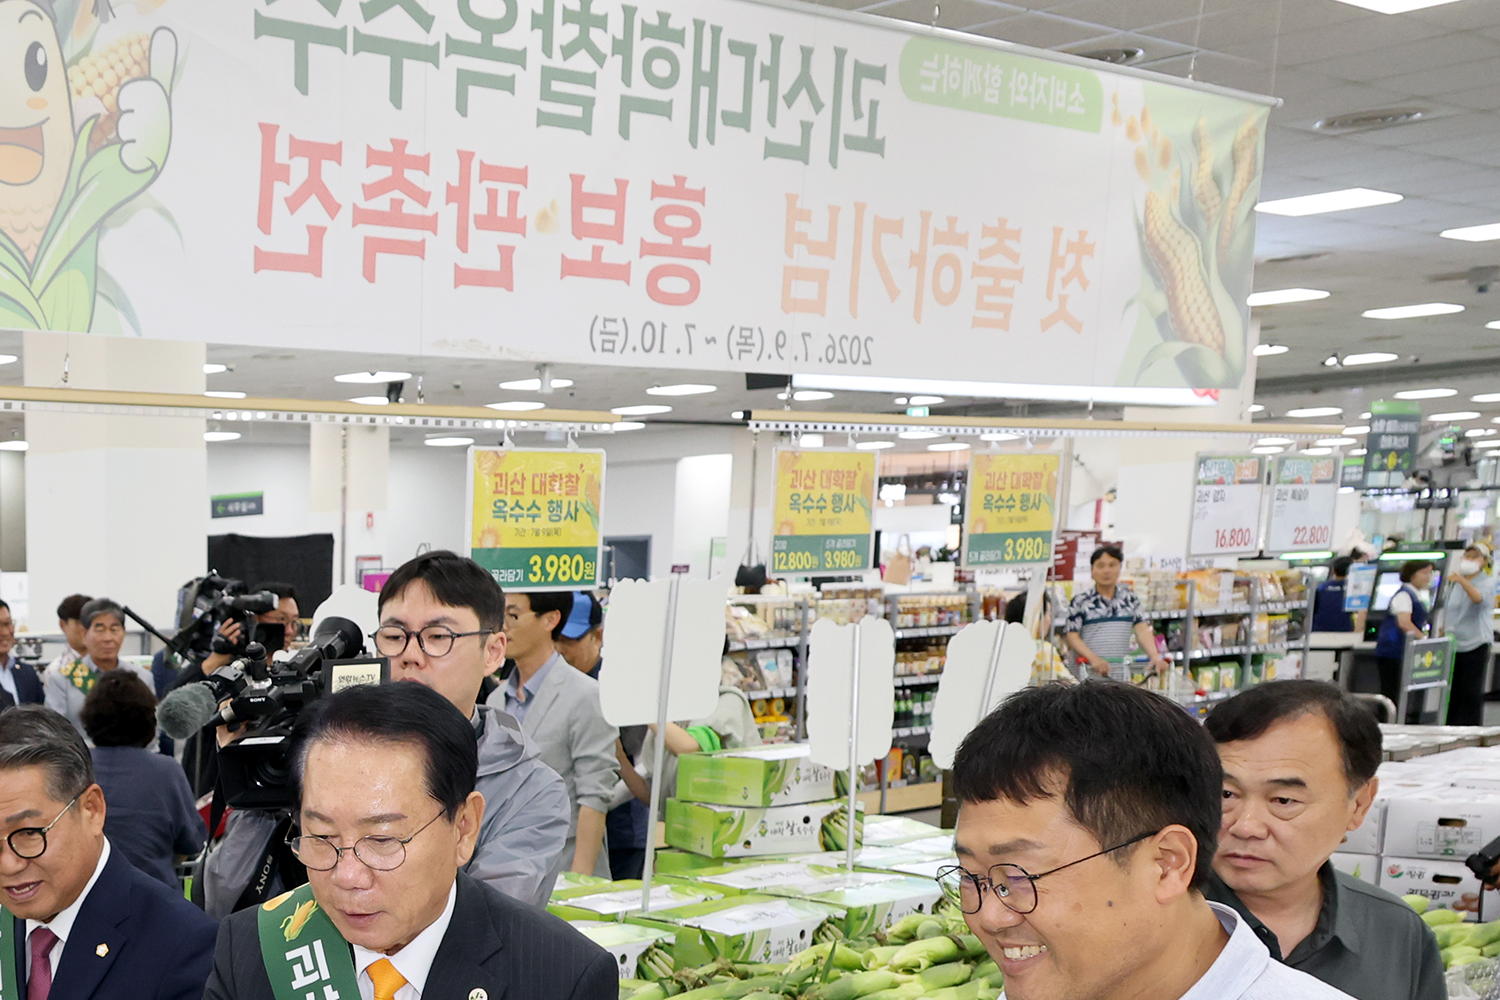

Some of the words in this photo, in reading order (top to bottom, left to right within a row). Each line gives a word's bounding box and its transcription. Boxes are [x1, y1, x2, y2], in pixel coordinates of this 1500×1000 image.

[492, 472, 526, 496] 괴산
[531, 472, 580, 496] 대학찰
[790, 469, 816, 490] 괴산
[820, 469, 858, 491] 대학찰
[984, 471, 1007, 491] 괴산
[492, 498, 542, 523] 옥수수
[547, 499, 580, 523] 행사
[789, 492, 828, 514] 옥수수
[831, 493, 856, 514] 행사
[983, 493, 1016, 513] 옥수수
[1020, 492, 1042, 512] 행사
[1215, 527, 1251, 548] 16,800
[1292, 525, 1329, 546] 22,800
[528, 553, 596, 583] 3,980원
